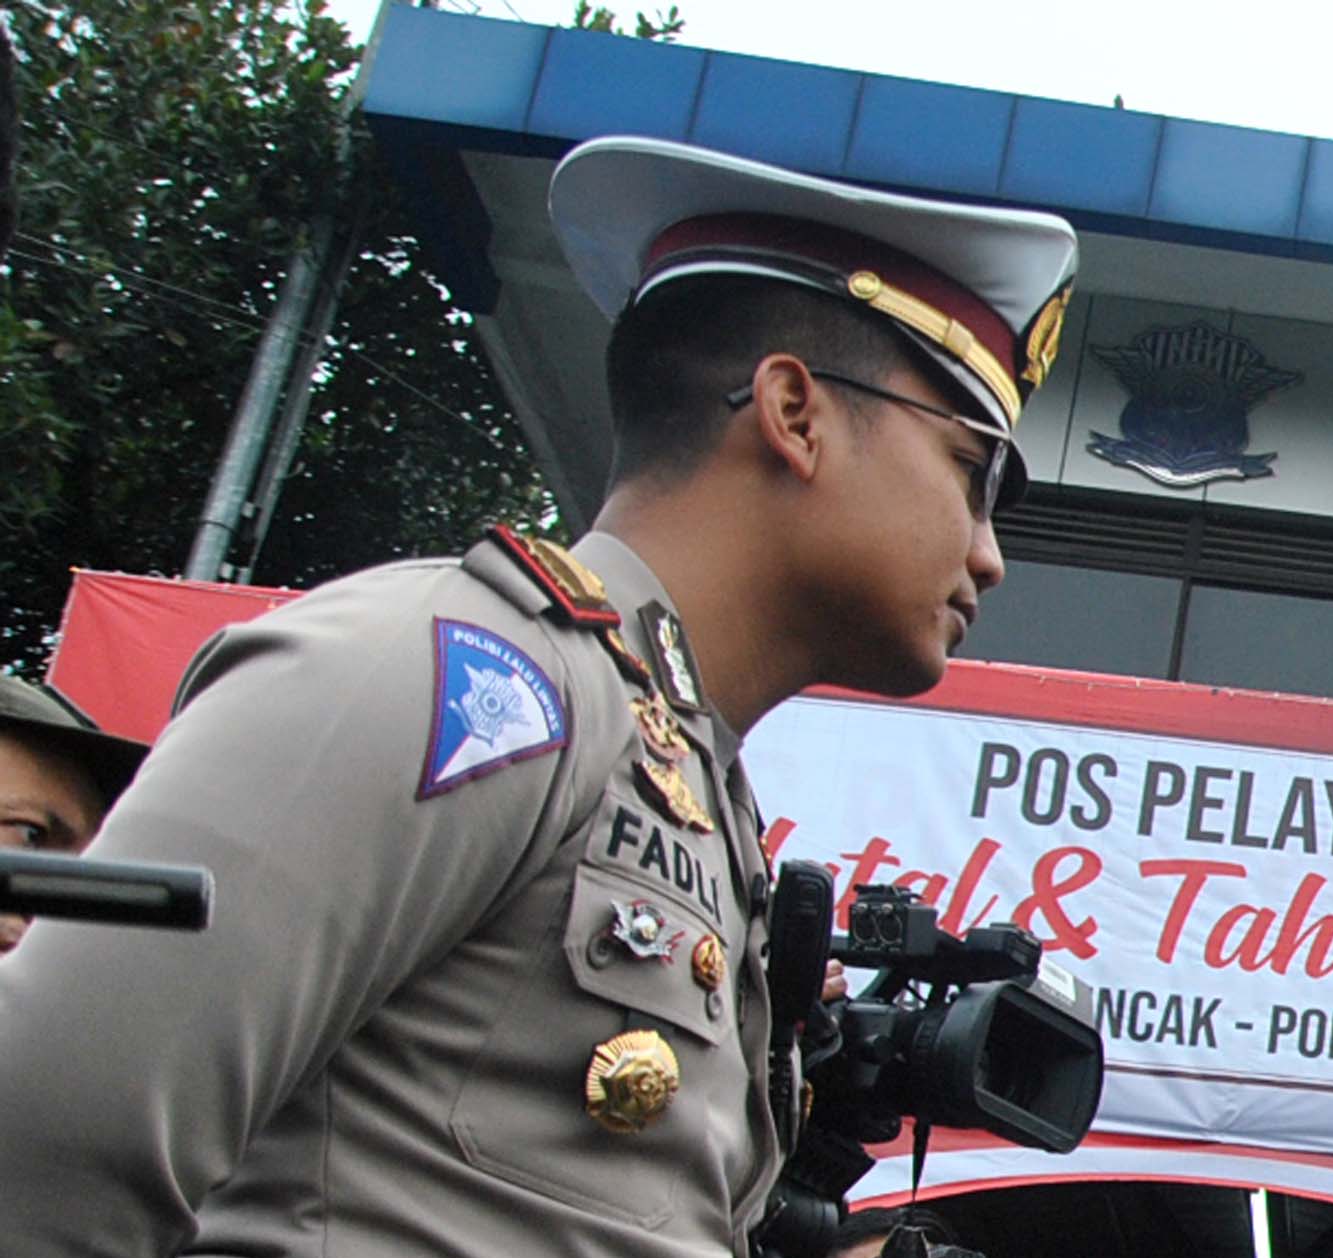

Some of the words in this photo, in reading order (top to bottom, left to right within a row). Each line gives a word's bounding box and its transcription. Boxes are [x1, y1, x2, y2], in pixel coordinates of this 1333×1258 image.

[971, 742, 1117, 831] POS
[607, 805, 722, 926] FADLI
[1011, 845, 1103, 961] &
[1094, 986, 1223, 1049] NCAK
